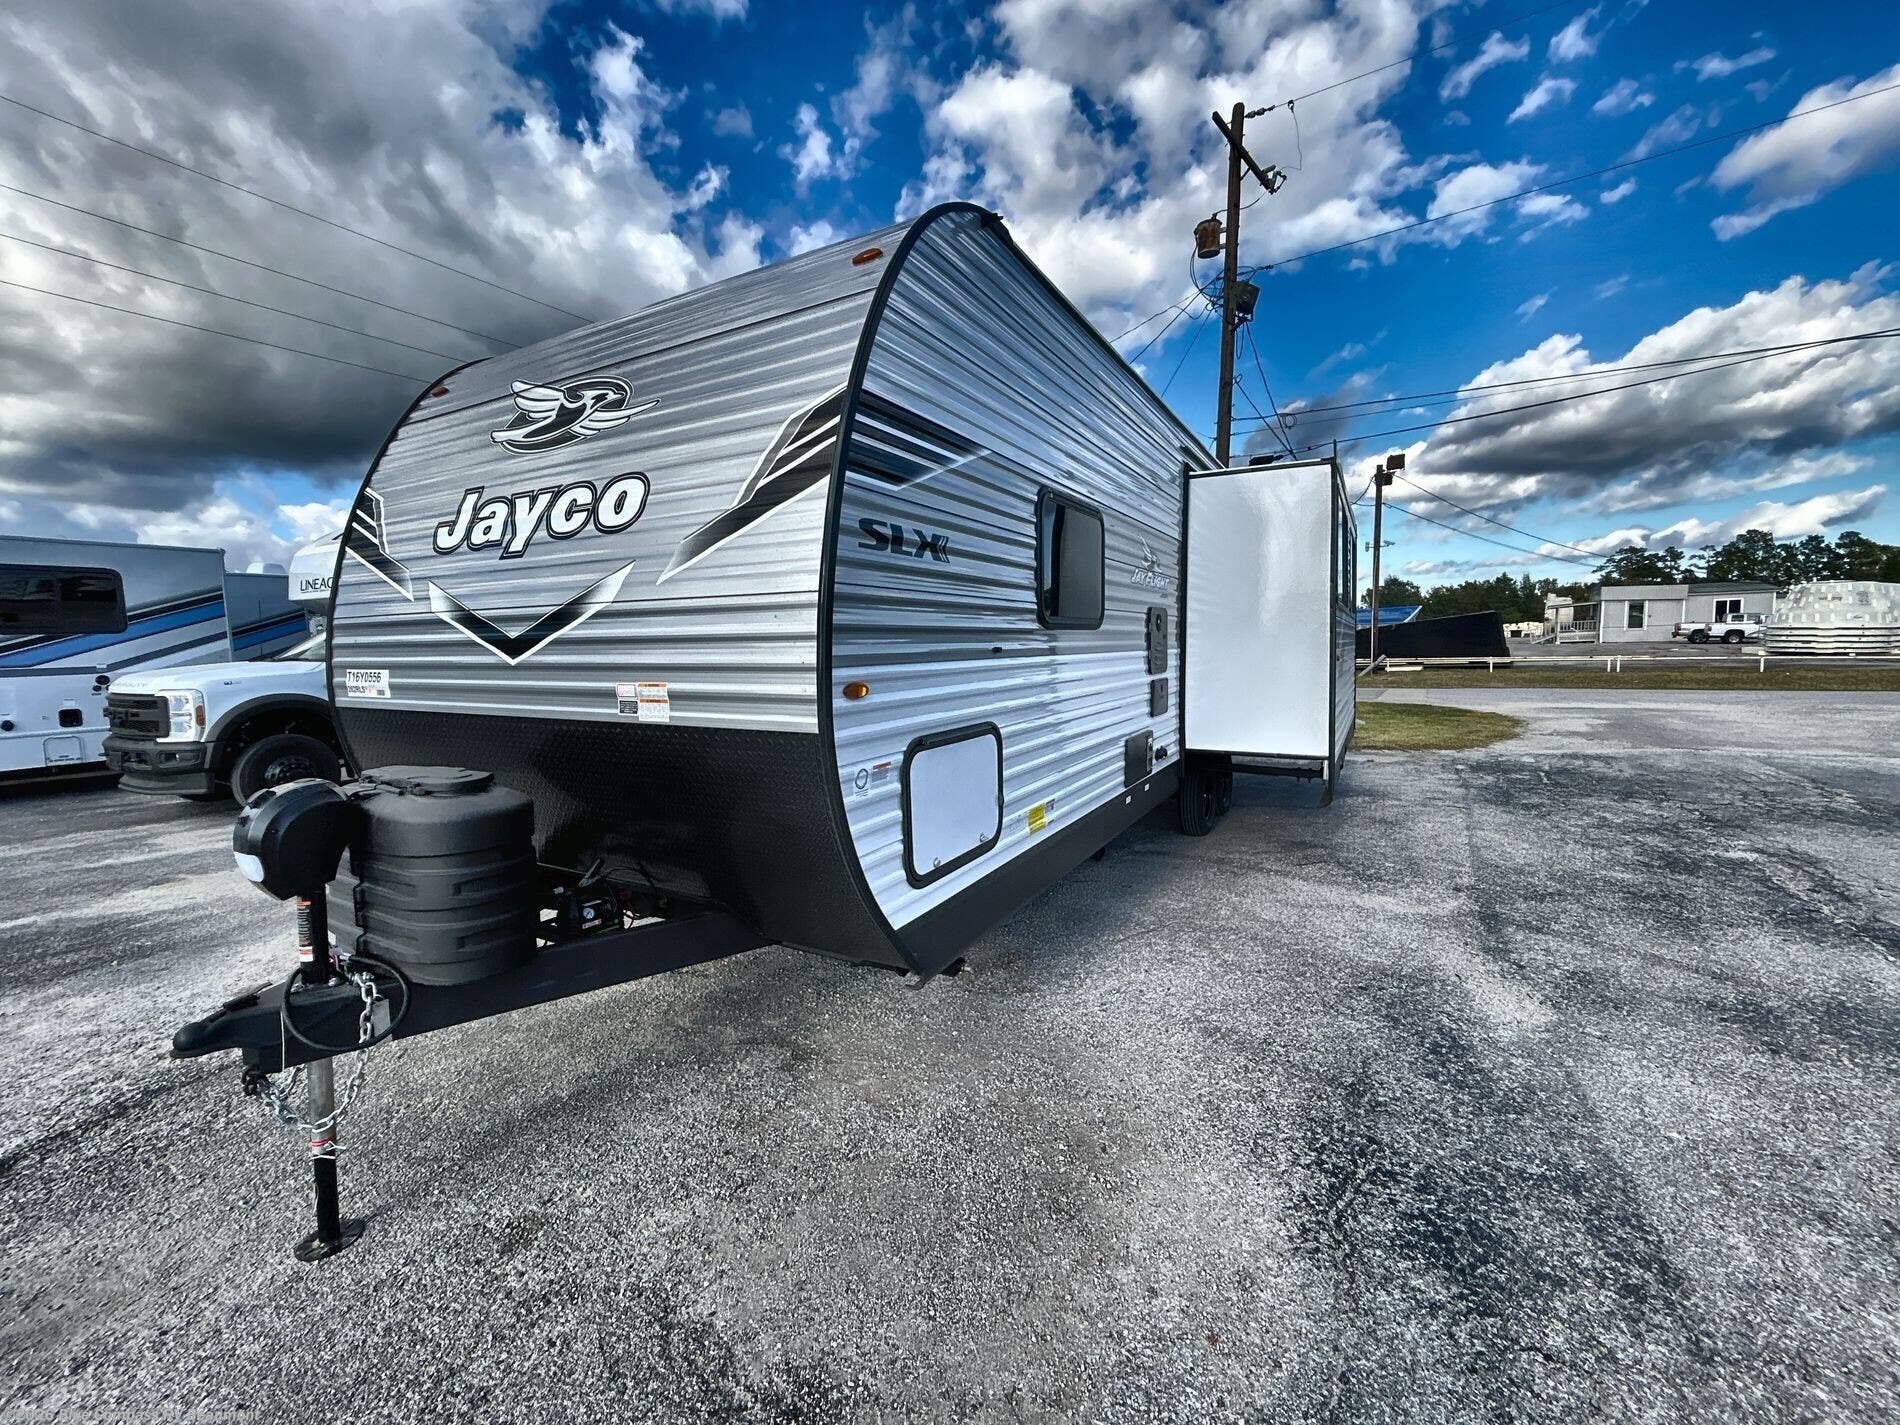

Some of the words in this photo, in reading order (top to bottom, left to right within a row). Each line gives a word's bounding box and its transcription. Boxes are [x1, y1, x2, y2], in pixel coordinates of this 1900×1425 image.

[433, 471, 650, 560] Jayco
[858, 518, 950, 563] SLX
[1131, 569, 1147, 586] JAY
[1145, 572, 1170, 590] FLIGHT
